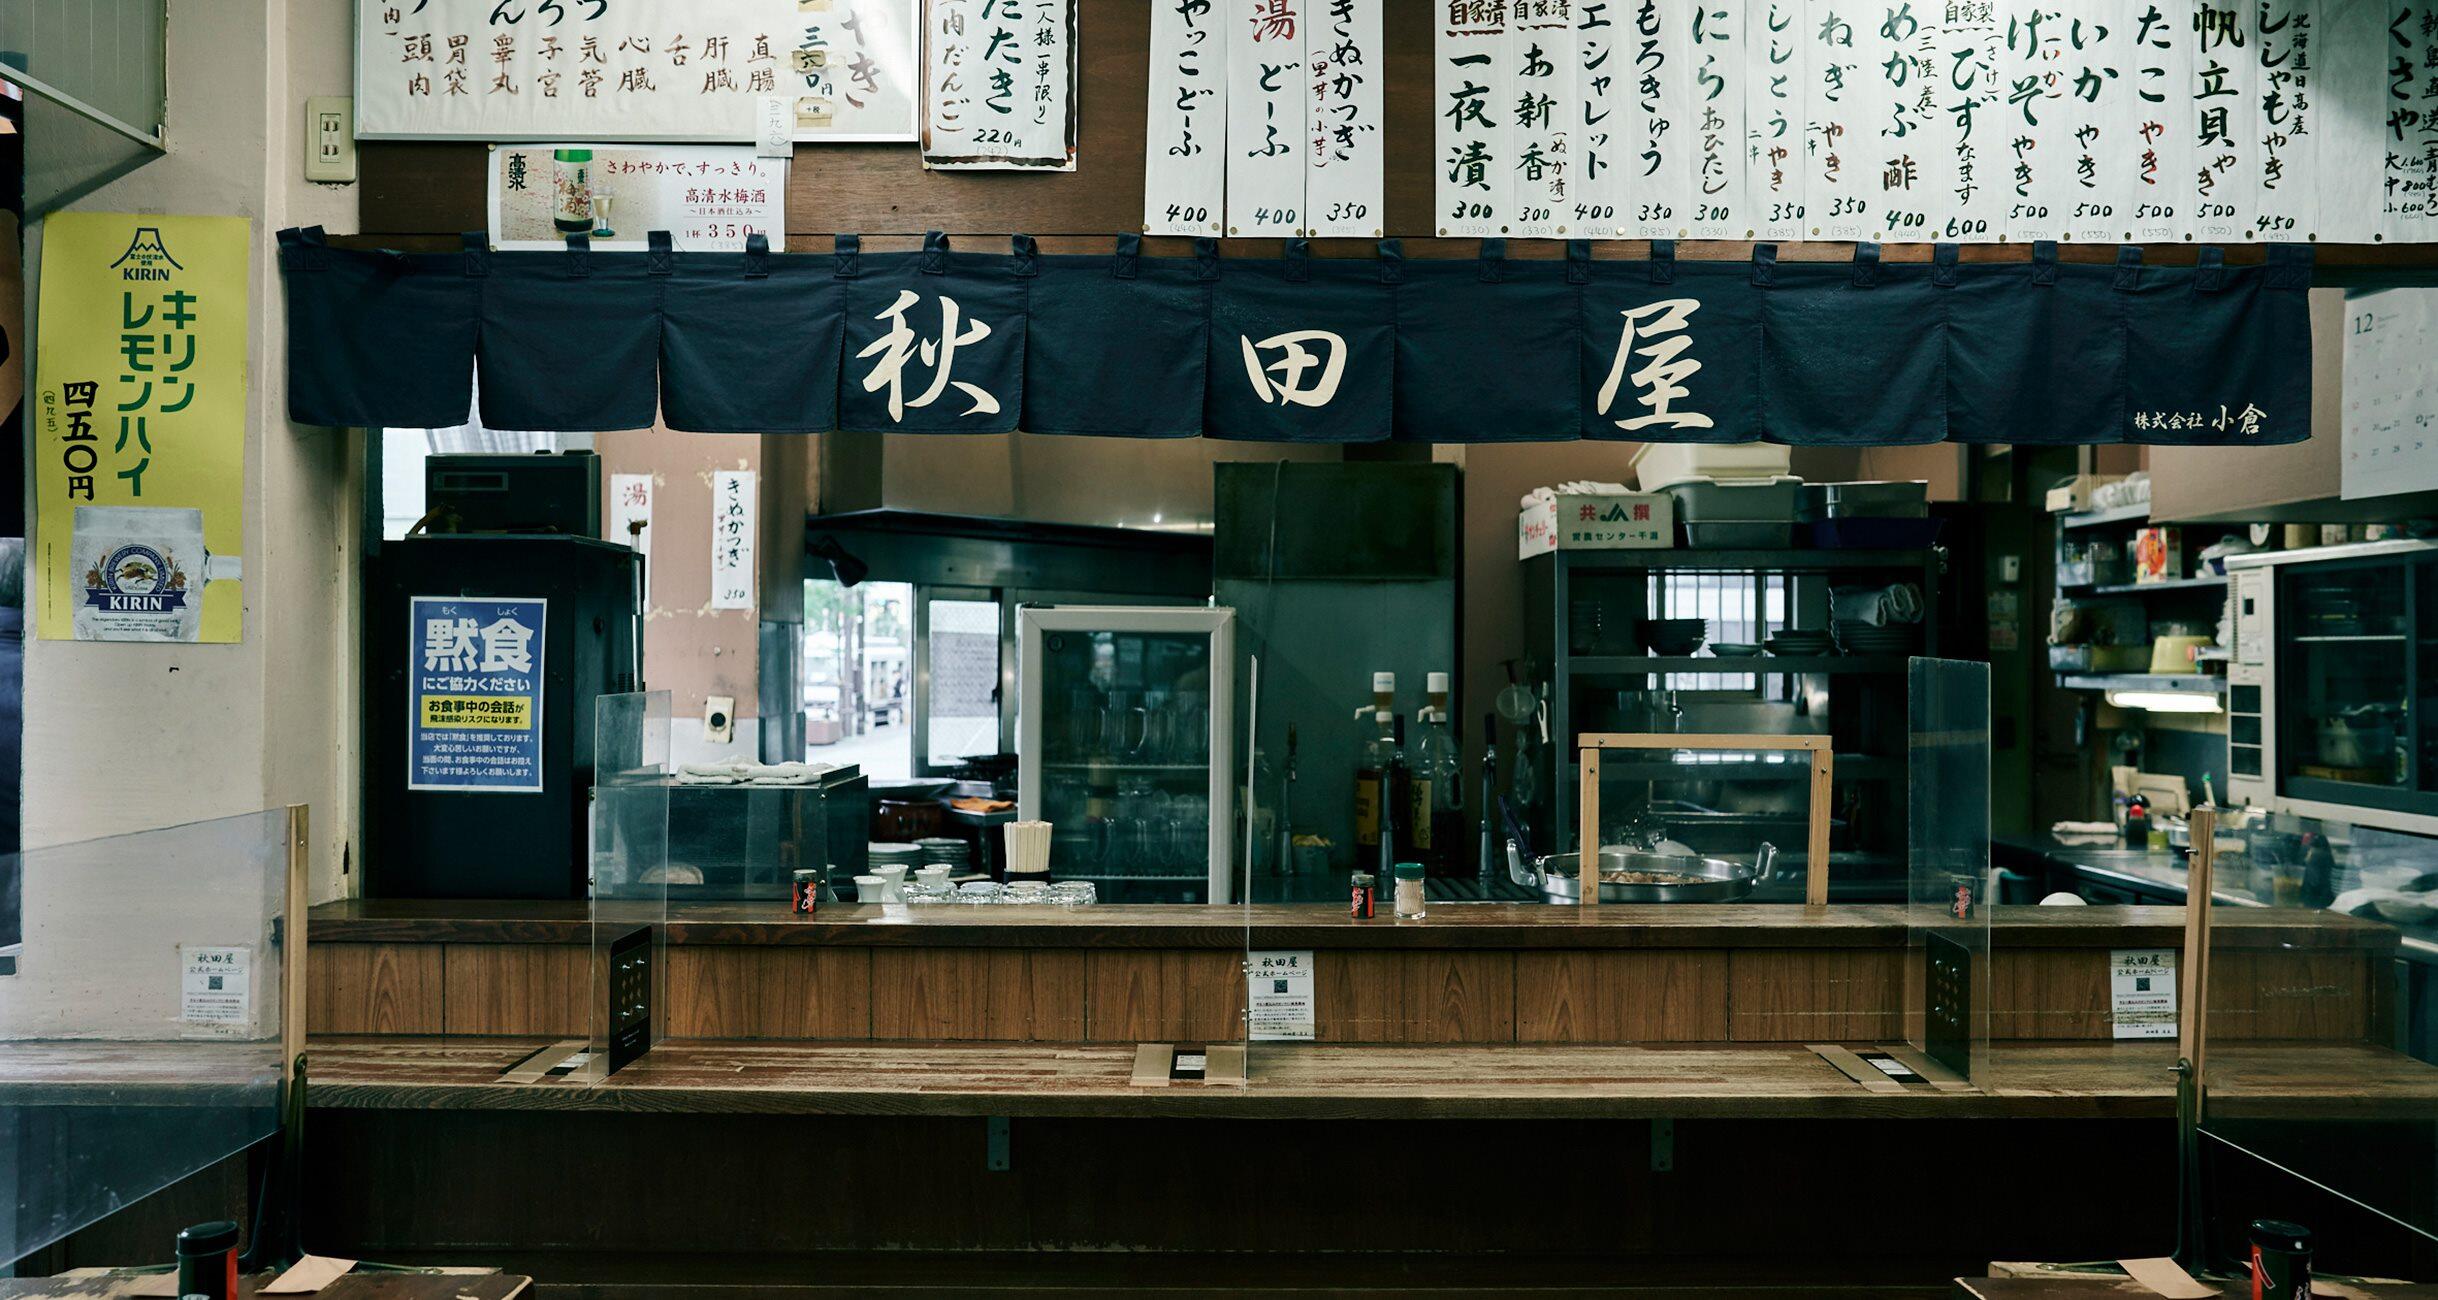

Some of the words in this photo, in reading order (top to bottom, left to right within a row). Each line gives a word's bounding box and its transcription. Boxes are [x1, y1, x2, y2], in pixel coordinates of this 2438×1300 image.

[1944, 1, 1996, 24] 自家製
[664, 33, 691, 66] 舌
[402, 33, 434, 97] 頭肉
[443, 34, 469, 96] 胃袋
[537, 35, 564, 98] 子宮
[746, 33, 777, 93] 直腸
[1248, 0, 1300, 157] 湯どーふ
[1329, 0, 1374, 161] きぬかつぎ
[2288, 13, 2311, 136] 北海道日高産
[2386, 7, 2420, 141] くさや
[1577, 3, 1612, 181] エシャレット
[1635, 0, 1670, 177] もろきゅう
[2136, 5, 2171, 185] たこやき
[2259, 3, 2291, 190] ししゃもやき
[2071, 17, 2119, 188] いかやき
[2193, 2, 2245, 197] 帆立貝やき
[1445, 54, 1497, 191] 一夜漬
[607, 160, 766, 178] さわやかで、すっきり。
[2385, 151, 2402, 170] 大
[685, 187, 766, 204] 高清水梅酒
[2402, 180, 2426, 192] 800
[1166, 204, 1207, 222] 400
[1255, 207, 1296, 225] 400
[1327, 202, 1367, 222] 350
[1451, 200, 1493, 219] 300
[1519, 206, 1550, 222] 300
[1574, 202, 1614, 220] 400
[1638, 203, 1672, 222] 350
[1694, 204, 1729, 221] 300
[1769, 202, 1805, 222] 350
[1829, 196, 1866, 217] 350
[2009, 203, 2048, 219] 500
[2073, 202, 2113, 218] 500
[2135, 203, 2174, 219] 500
[2197, 203, 2235, 218] 500
[2383, 202, 2398, 213] 小
[2402, 202, 2424, 213] 600
[1885, 209, 1925, 231] 400
[1946, 217, 1987, 238] 600
[2256, 215, 2295, 232] 450
[123, 268, 169, 281] KIRIN
[2354, 313, 2373, 335] 12
[161, 290, 196, 412] キリン
[115, 291, 154, 497] レモンハイ
[2134, 411, 2204, 430] 株式会社
[2211, 402, 2267, 435] 小倉
[623, 482, 647, 506] 湯
[727, 478, 749, 568] きぬかつぎ
[1580, 503, 1596, 522] 共
[109, 596, 162, 611] KIRIN
[724, 589, 745, 600] 350
[442, 606, 457, 615] もく
[497, 607, 518, 615] しょく
[424, 618, 534, 673] 黙食
[422, 676, 530, 691] にご協力ください
[429, 700, 524, 713] お食事中の会話が
